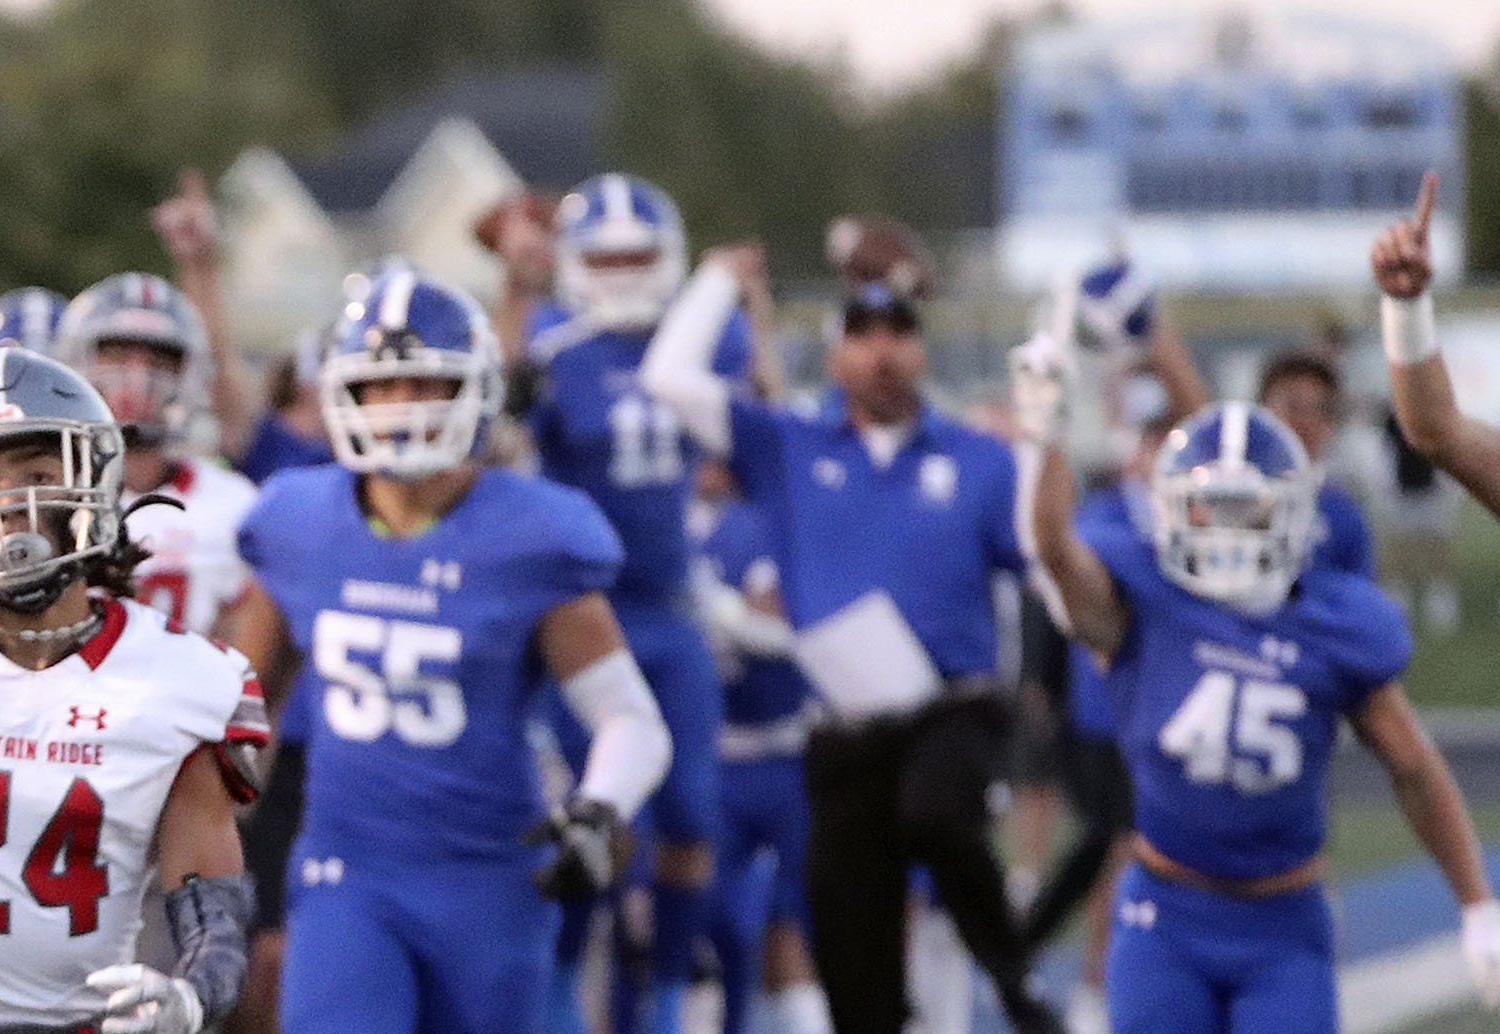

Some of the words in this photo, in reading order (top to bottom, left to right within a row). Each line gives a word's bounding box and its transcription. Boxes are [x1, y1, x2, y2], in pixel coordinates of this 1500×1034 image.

[312, 608, 468, 750] 55
[1157, 669, 1309, 796] 45
[46, 741, 103, 766] RIDGE
